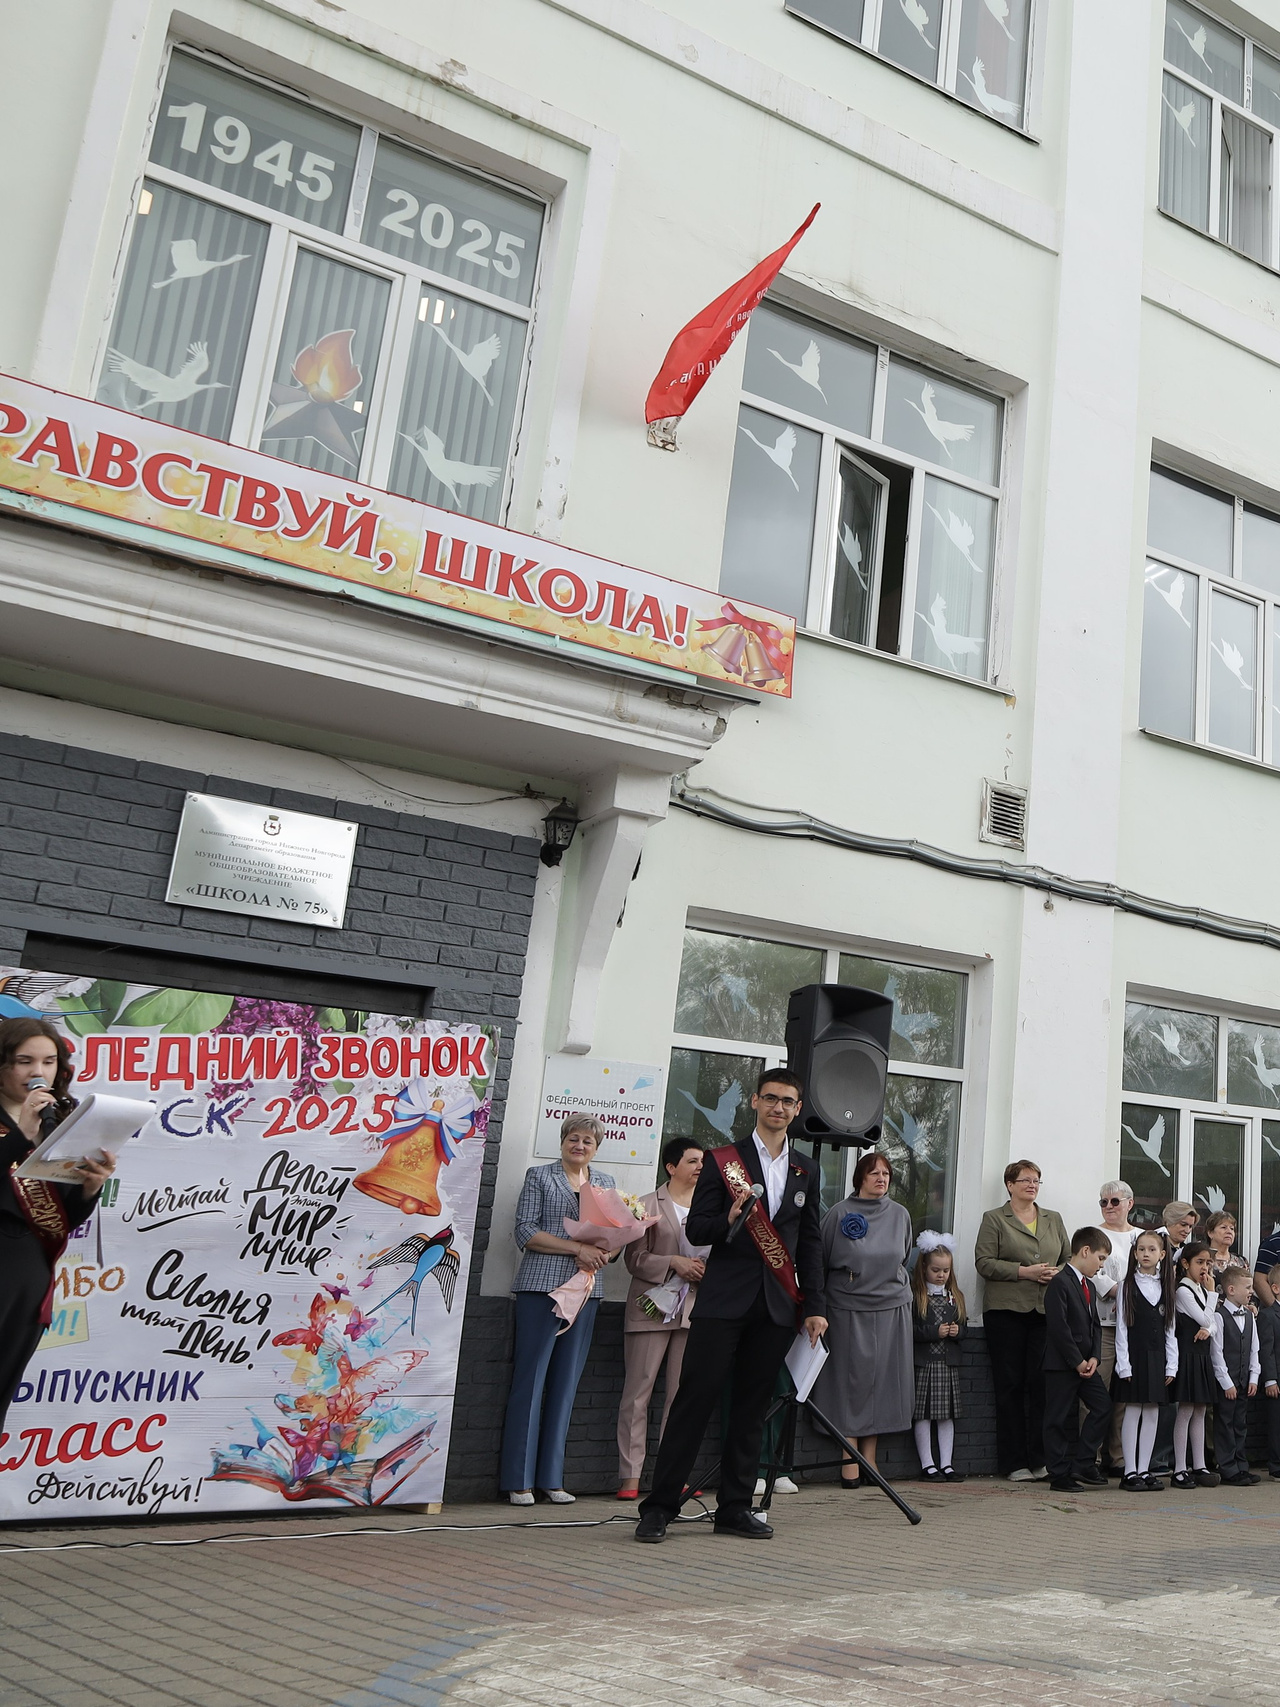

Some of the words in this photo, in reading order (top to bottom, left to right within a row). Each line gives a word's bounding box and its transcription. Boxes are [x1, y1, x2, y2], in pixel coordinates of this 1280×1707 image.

[167, 102, 336, 201] 1945
[380, 188, 525, 279] 2025
[418, 529, 691, 646] ШКОЛА!
[199, 828, 254, 842] Администрация
[229, 840, 273, 854] Департамент
[194, 850, 276, 870] МУНИЦИПАЛЬНОЕ
[277, 863, 333, 880] БЮДЖЕТНОЕ
[209, 860, 317, 884] ОБЩЕОБРАЗОВАТЕЛЬНОЕ
[232, 873, 292, 888] УЧРЕЖДЕНИЕ
[186, 883, 271, 907] «ШКОЛА
[276, 896, 298, 911] №
[304, 901, 329, 915] 75»
[315, 1035, 489, 1080] ЗВОНОК
[134, 1093, 246, 1138] СК
[263, 1094, 399, 1138] 2025
[545, 1108, 581, 1121] УСП
[546, 1094, 618, 1110] ФЕДЕРАЛЬНЫЙ
[620, 1102, 655, 1113] ПРОЕКТ
[243, 1149, 357, 1205] Делай
[122, 1177, 232, 1223] Мечтай
[759, 1237, 790, 1269] 2025
[146, 1249, 273, 1325] Сегодня
[120, 1301, 189, 1334] твой
[163, 1319, 272, 1371] День!
[27, 1456, 204, 1515] Действуй!
